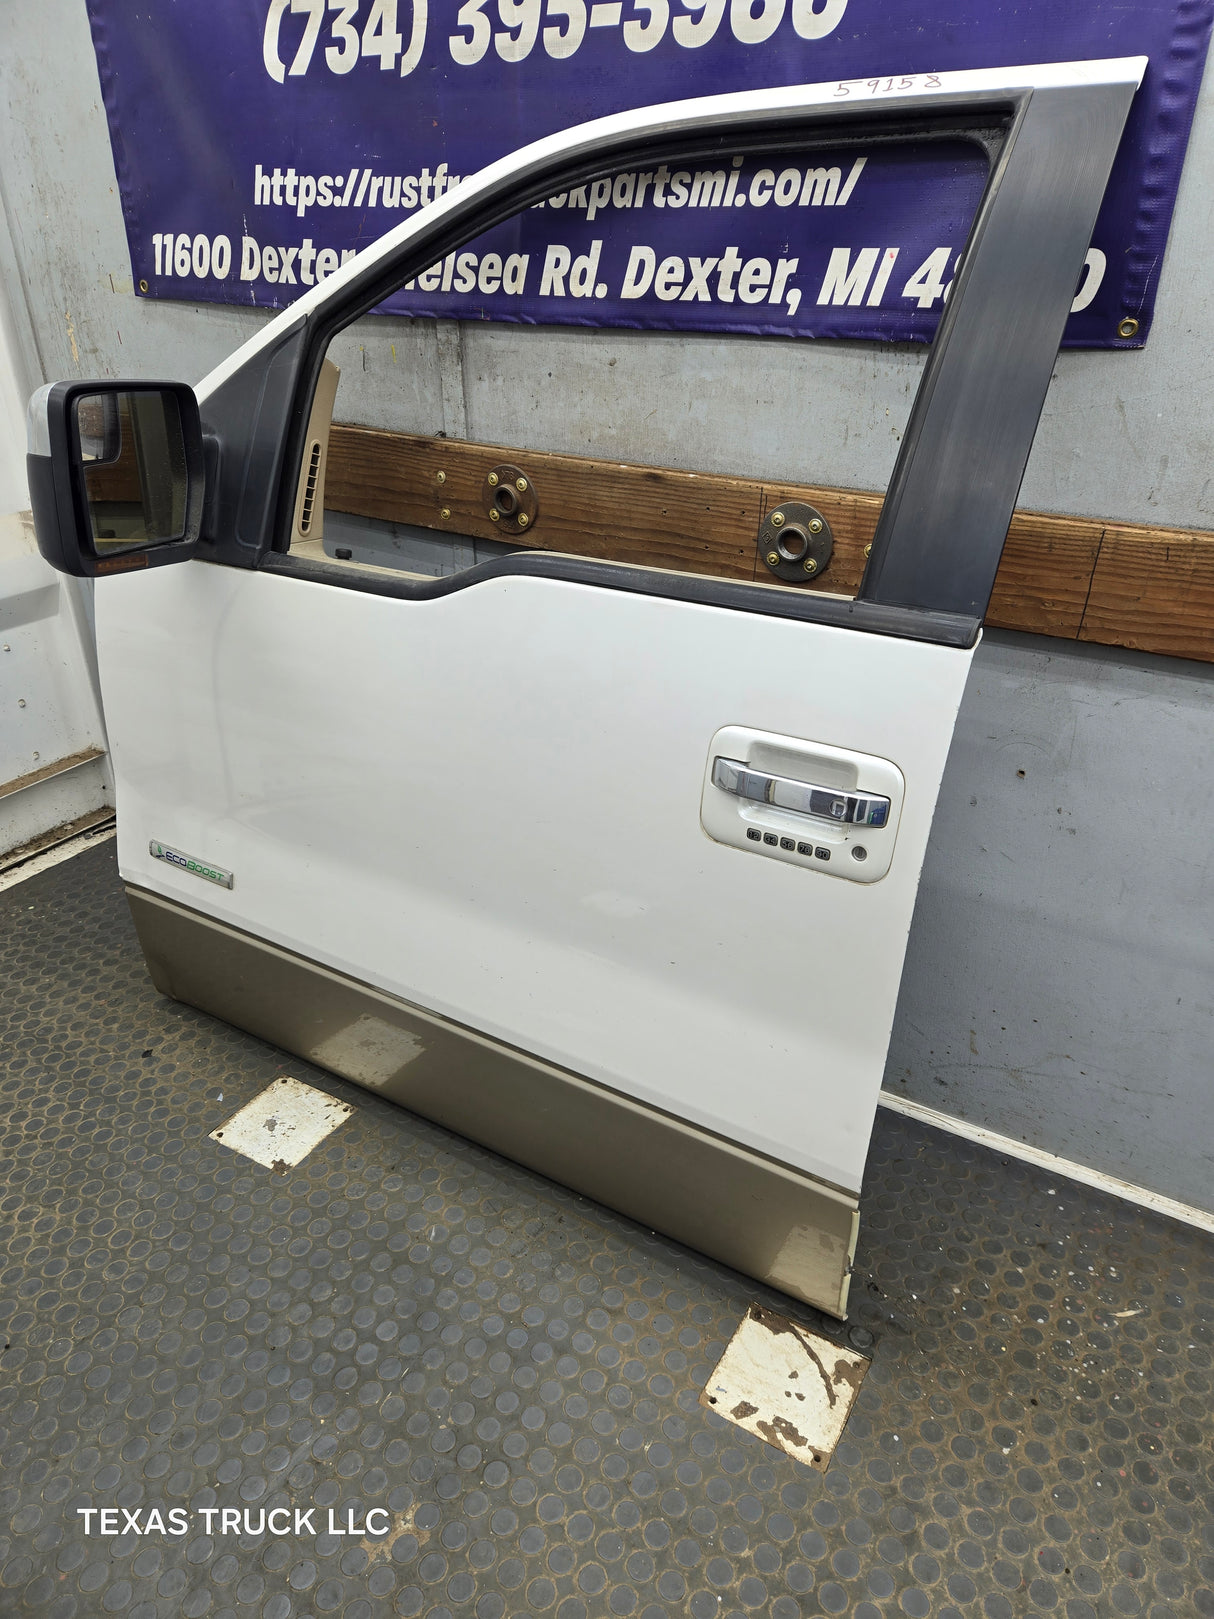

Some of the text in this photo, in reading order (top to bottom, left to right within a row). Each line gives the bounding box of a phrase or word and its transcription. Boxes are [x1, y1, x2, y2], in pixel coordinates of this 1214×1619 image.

[263, 0, 428, 84] (734)
[152, 233, 232, 280] 11600
[538, 239, 608, 299] Rd.
[620, 245, 802, 316] Dexter,
[815, 247, 900, 307] MI
